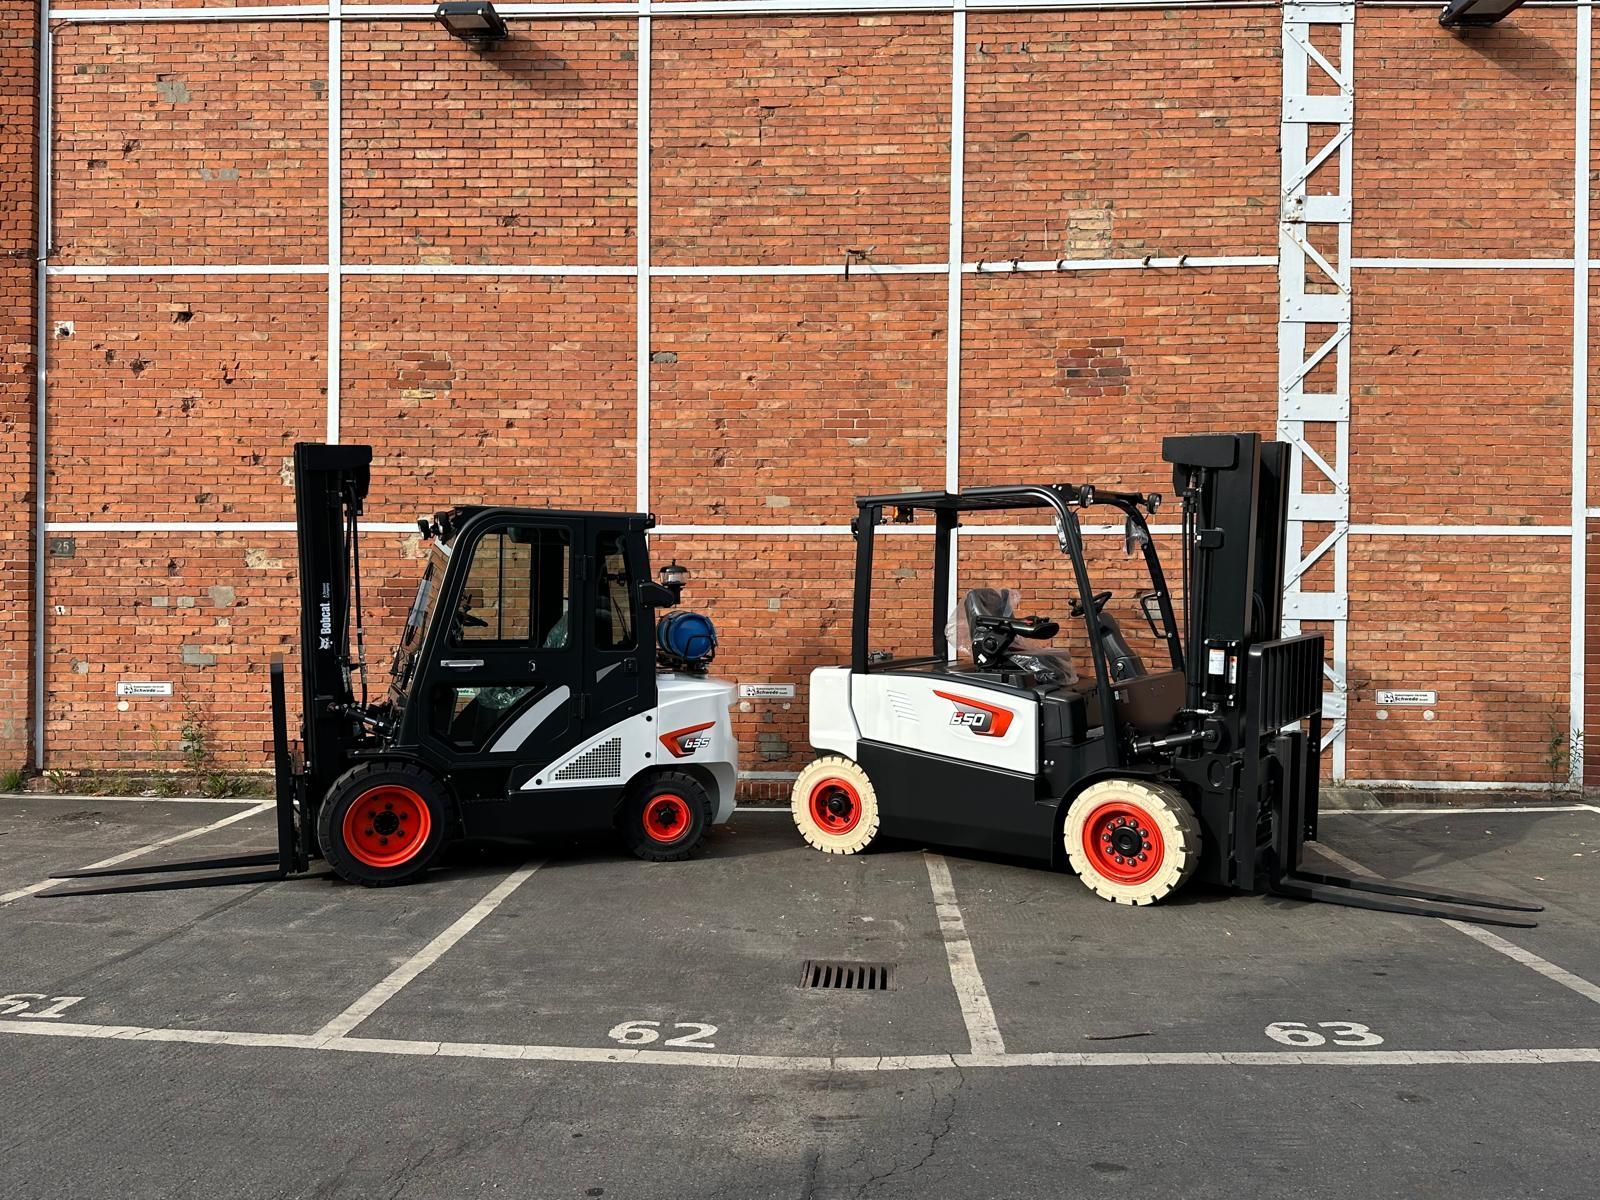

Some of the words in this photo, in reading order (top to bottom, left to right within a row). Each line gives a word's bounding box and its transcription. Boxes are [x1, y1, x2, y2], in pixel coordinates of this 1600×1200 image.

[319, 603, 331, 635] Bobcat
[949, 712, 986, 726] B50
[684, 738, 710, 748] G35
[608, 1021, 718, 1048] 62
[1264, 1021, 1384, 1047] 63
